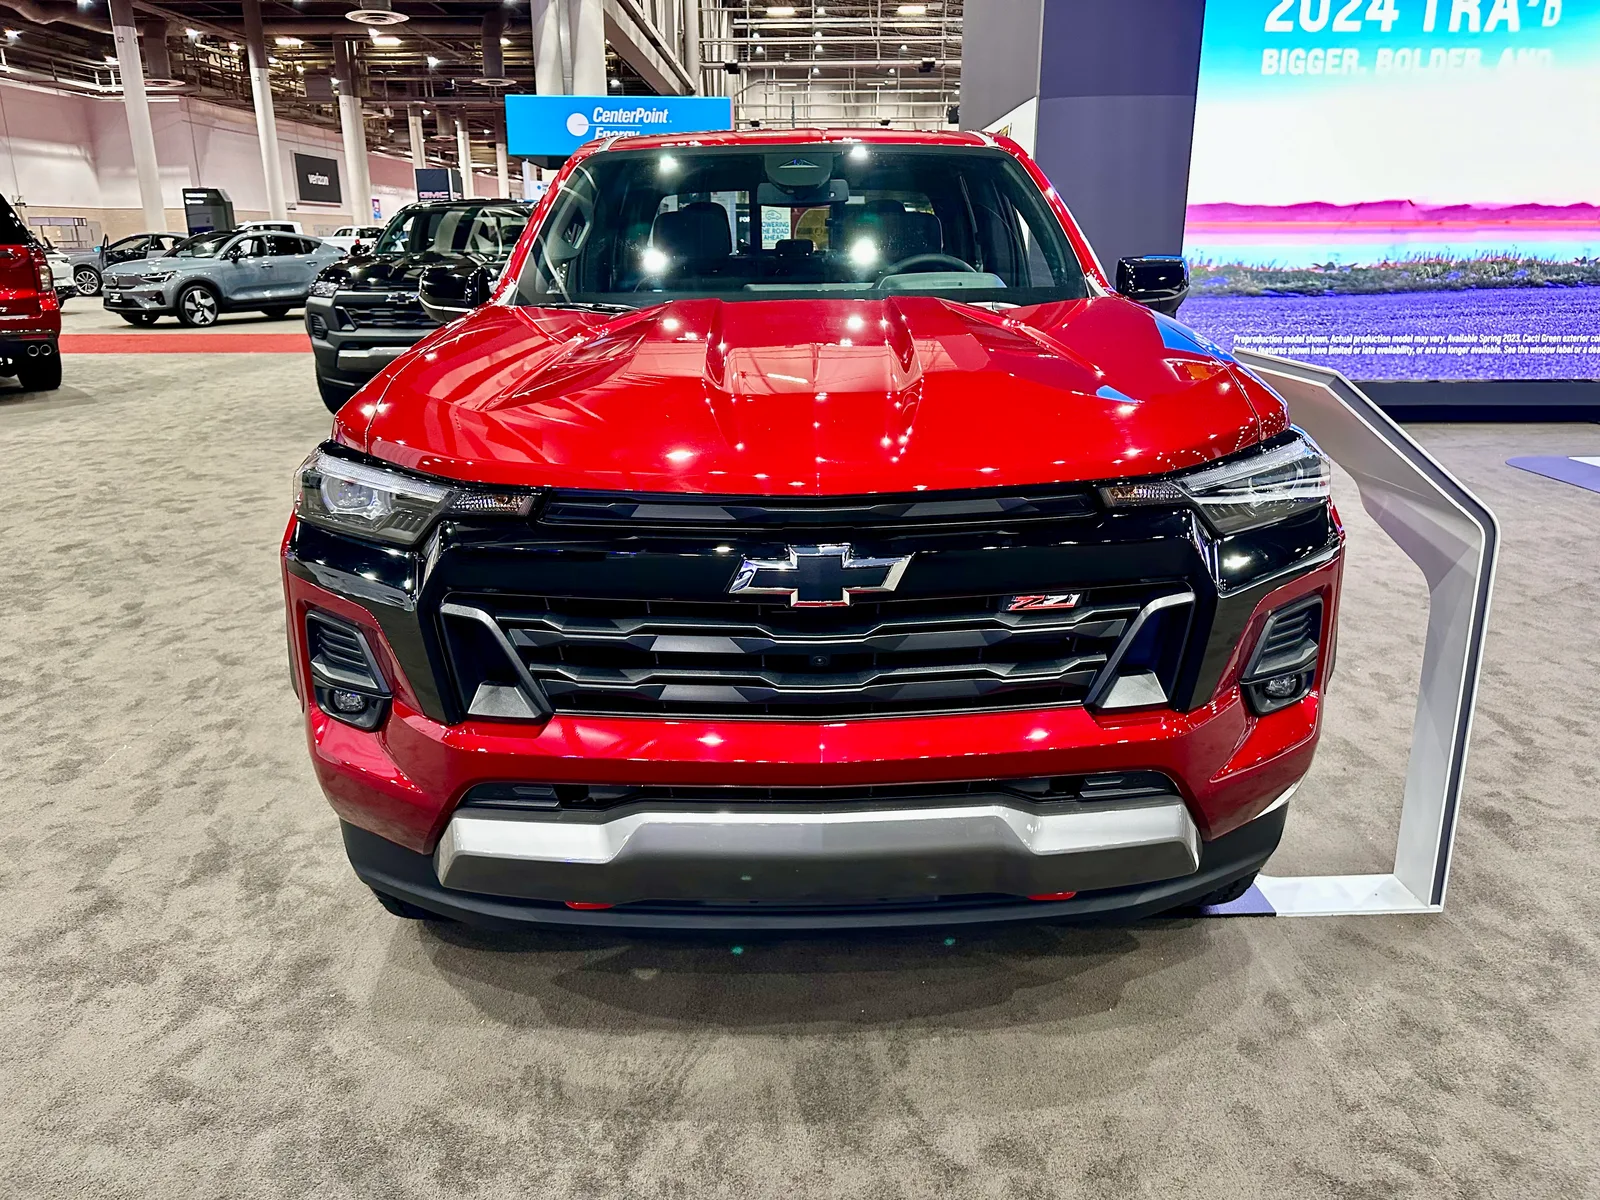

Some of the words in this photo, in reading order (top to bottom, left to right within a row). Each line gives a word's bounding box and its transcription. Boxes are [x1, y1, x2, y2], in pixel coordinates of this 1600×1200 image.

[1264, 0, 1400, 32] 2024
[307, 172, 330, 186] verizon
[419, 191, 449, 199] GMC
[1233, 334, 1283, 345] Preproduction
[1283, 334, 1305, 343] model
[1330, 334, 1353, 343] Actual
[1353, 334, 1391, 345] production
[1392, 334, 1413, 343] model
[1414, 335, 1430, 345] may
[1447, 334, 1478, 343] Available
[1479, 334, 1502, 345] Spring
[1541, 334, 1561, 342] Green
[1562, 334, 1590, 342] exterior
[1258, 345, 1287, 354] features
[1287, 345, 1310, 354] shown
[1311, 345, 1328, 354] have
[1328, 345, 1353, 354] limited
[1361, 345, 1376, 354] late
[1424, 346, 1437, 354] are
[1437, 346, 1447, 354] no
[1447, 345, 1470, 356] longer
[1503, 345, 1517, 353] See
[1517, 345, 1530, 353] the
[1529, 345, 1556, 353] window
[1556, 345, 1574, 353] label
[1006, 593, 1080, 611] Z71
